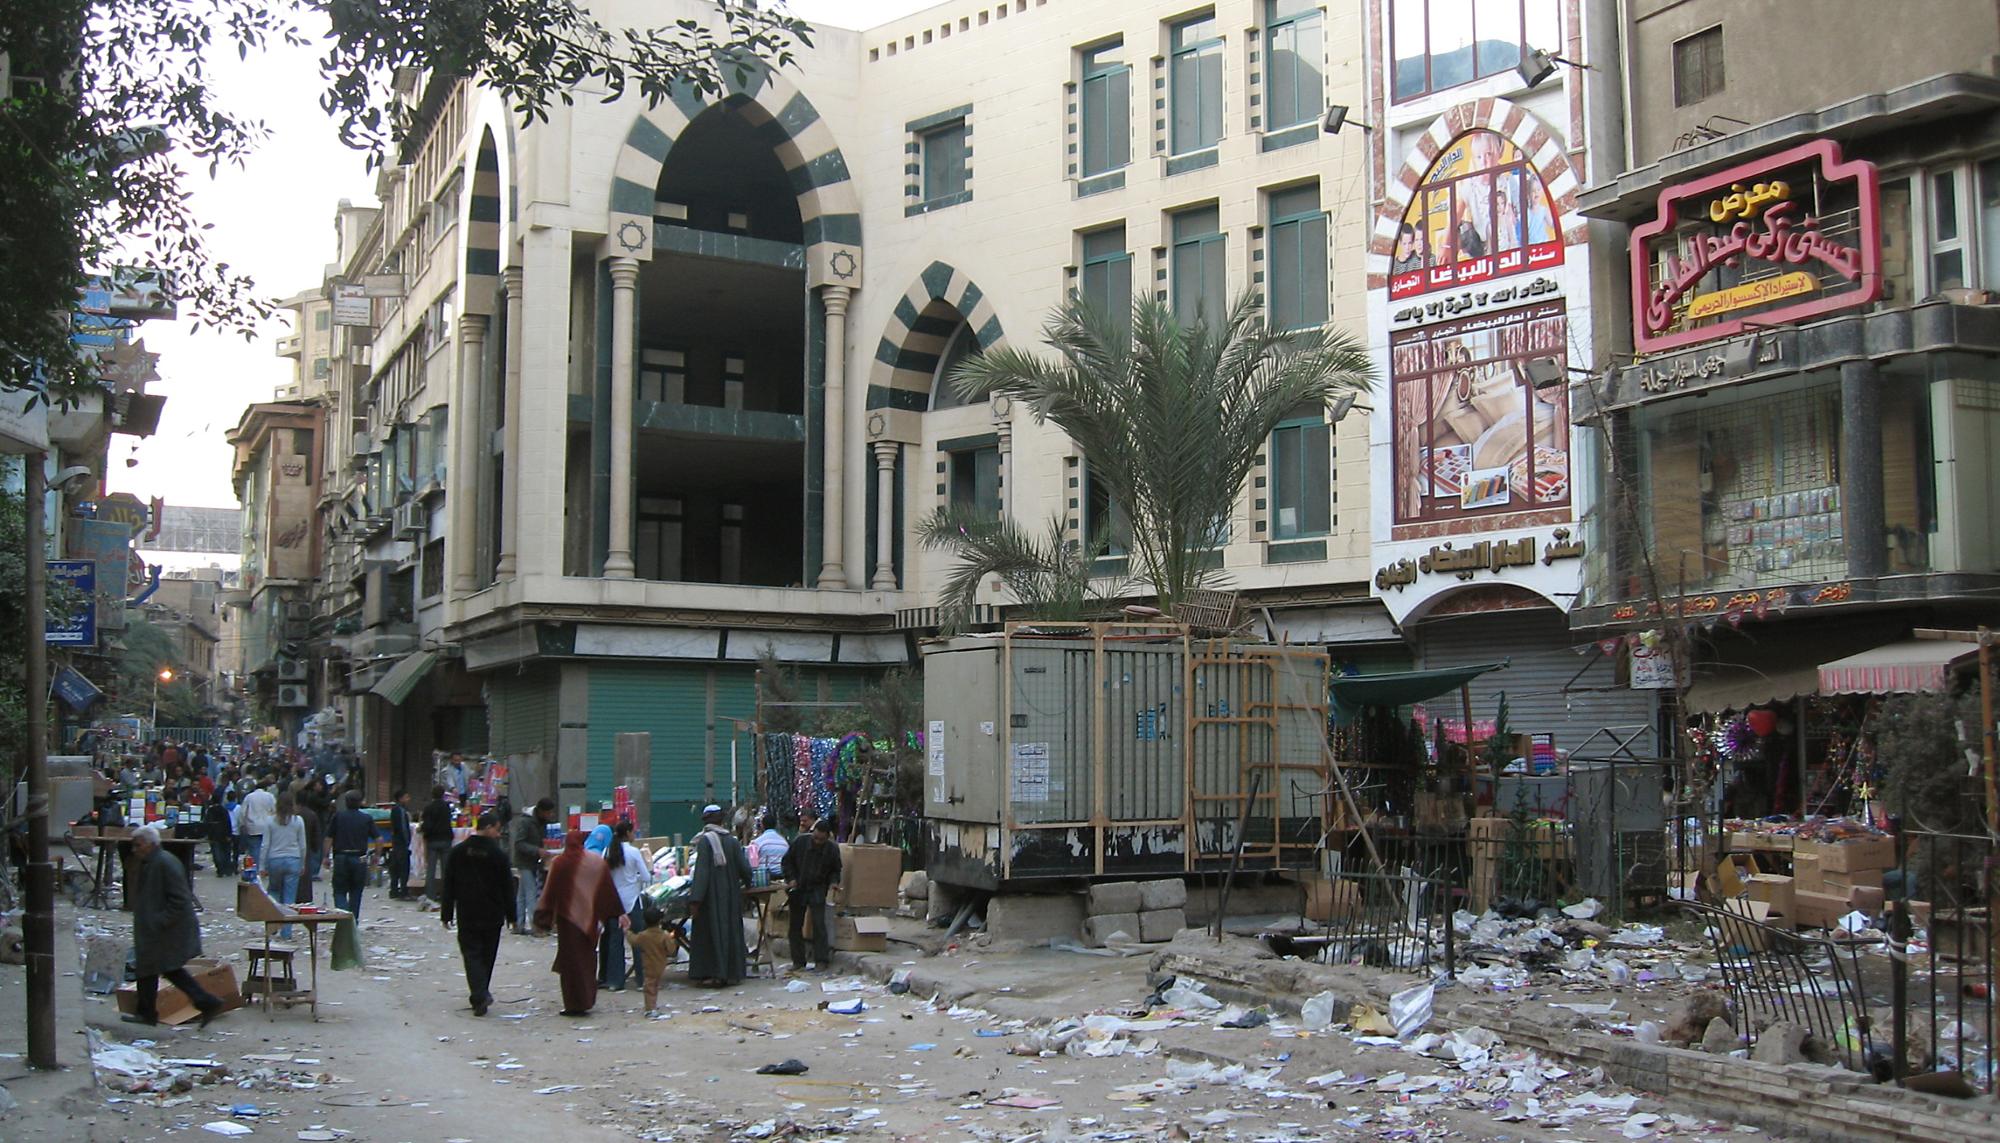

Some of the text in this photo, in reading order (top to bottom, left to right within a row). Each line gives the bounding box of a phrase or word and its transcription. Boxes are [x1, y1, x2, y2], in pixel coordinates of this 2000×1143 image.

[1710, 180, 1791, 223] معرض
[1706, 221, 1750, 270] عبد
[1528, 248, 1556, 265] سنتر
[1445, 292, 1473, 315] قوة
[1475, 291, 1489, 306] لا
[1491, 286, 1517, 304] الله
[1393, 304, 1425, 323] بالله
[1425, 301, 1444, 319] إلا
[1536, 306, 1559, 318] سنتر
[1490, 536, 1536, 574] الدار
[1541, 527, 1586, 566] سنتر
[1418, 541, 1491, 581] البيضاء
